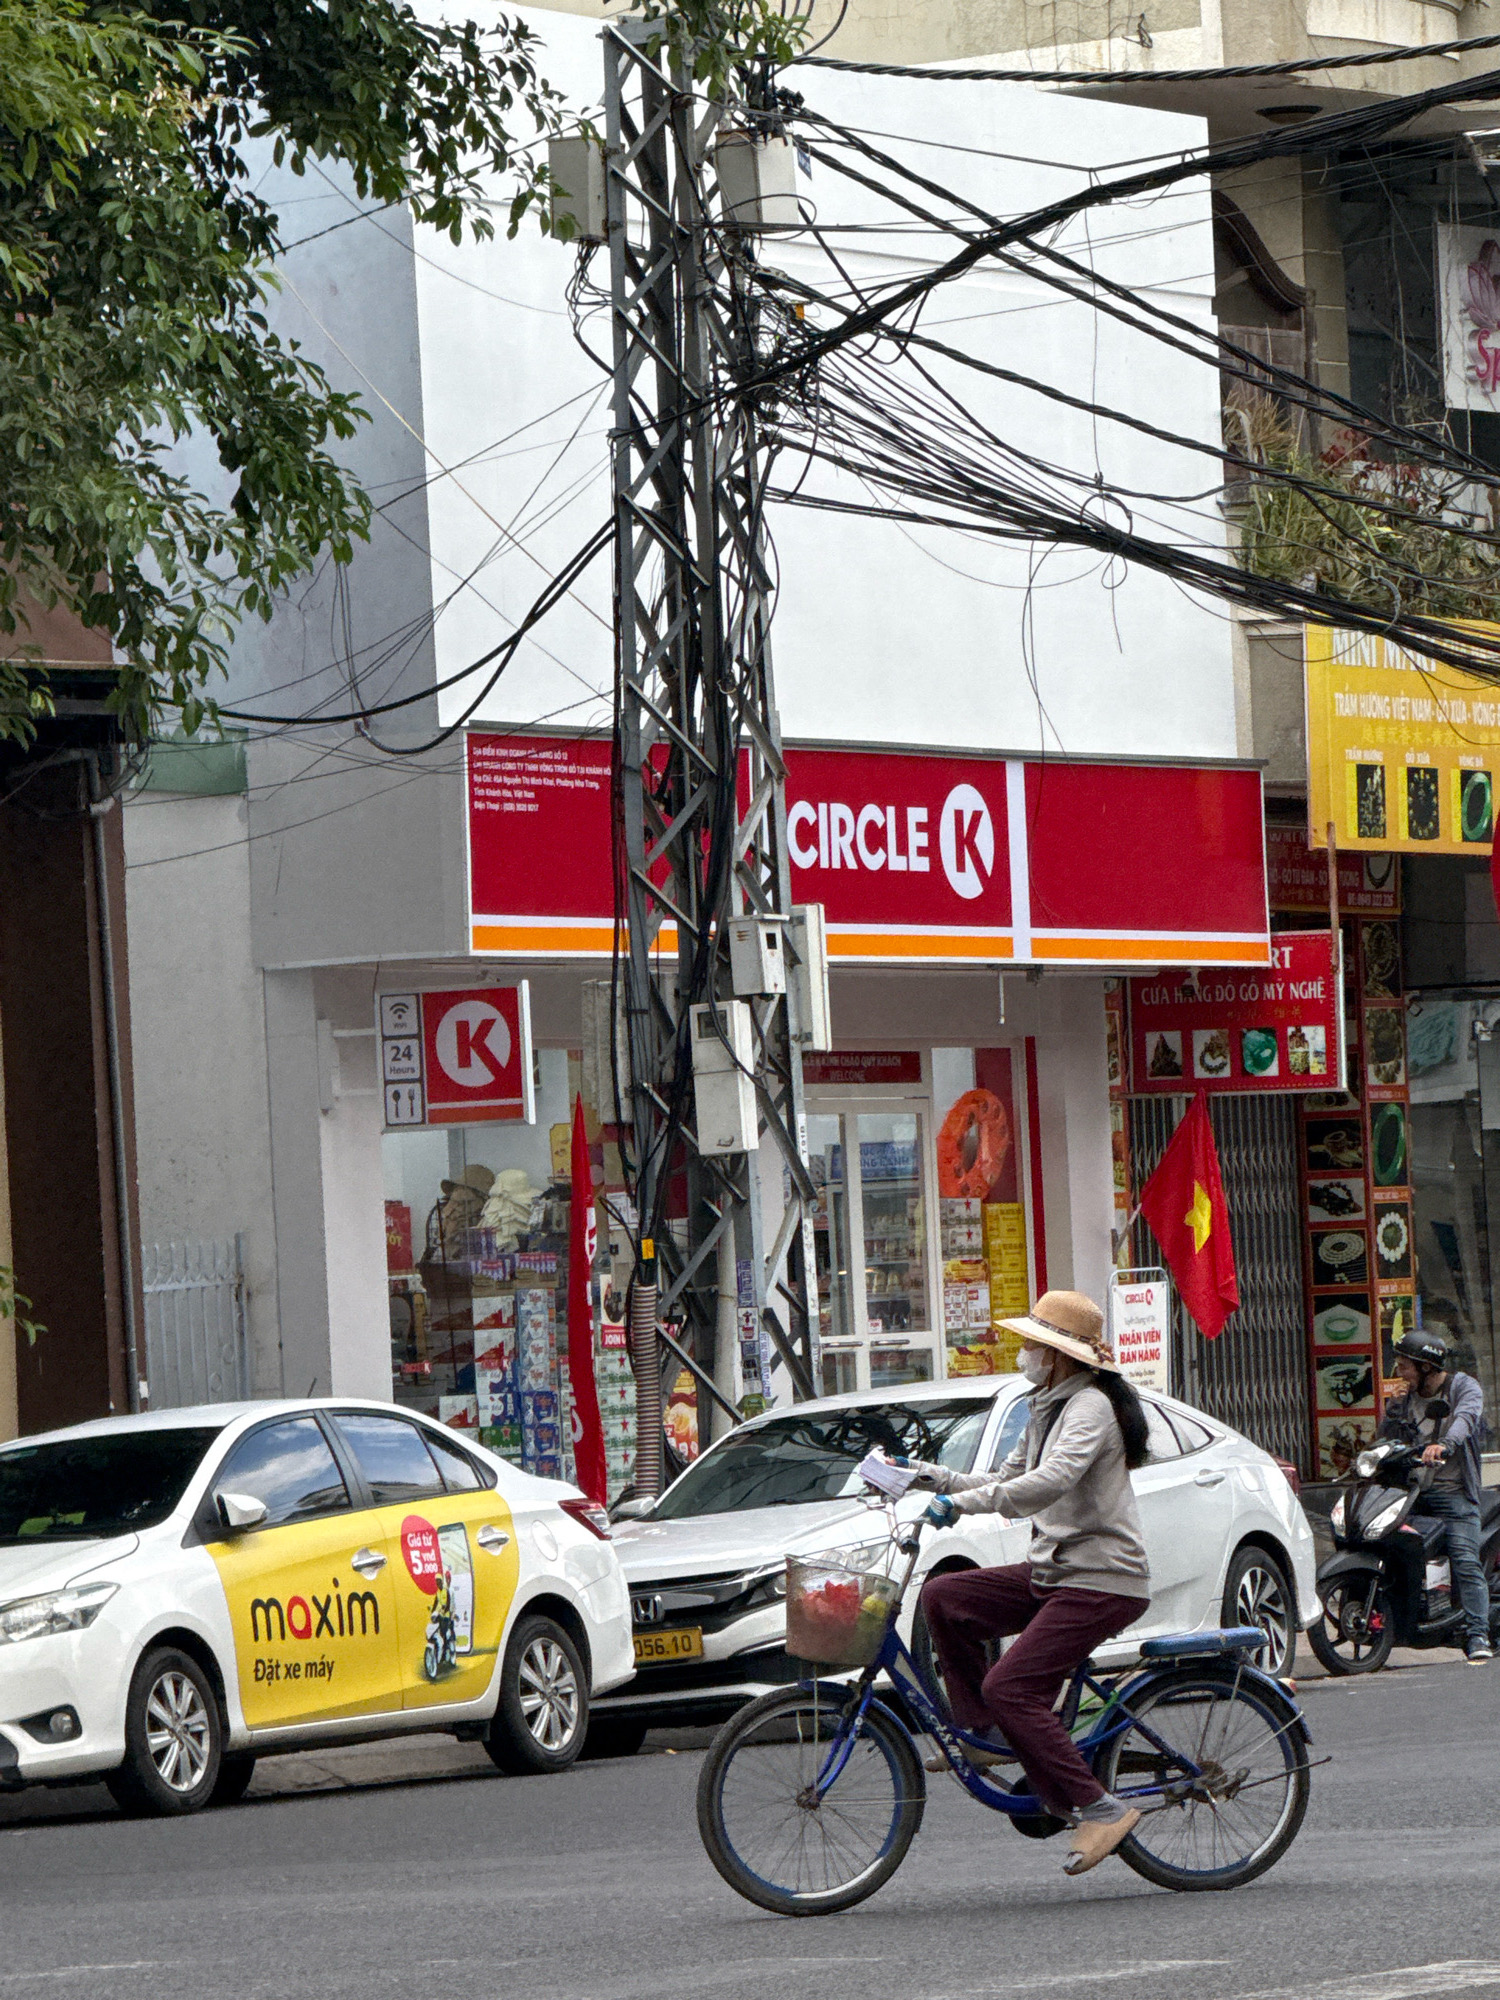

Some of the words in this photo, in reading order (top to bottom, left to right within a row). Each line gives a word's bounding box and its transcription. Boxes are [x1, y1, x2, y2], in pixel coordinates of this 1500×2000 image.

[1412, 697, 1432, 721] NAM
[787, 800, 930, 872] CIRCLE
[947, 796, 994, 897] K
[1271, 946, 1294, 969] RT
[1215, 977, 1235, 1002] ĐỒ
[1239, 975, 1260, 1001] GỖ
[1263, 977, 1284, 1001] MỸ
[1290, 976, 1326, 1004] NGHỆ
[391, 1045, 413, 1061] 24
[445, 1009, 510, 1085] K
[389, 1066, 416, 1075] Hours
[1125, 1293, 1145, 1304] CIRCLE
[604, 1334, 621, 1346] JOIN
[1119, 1329, 1142, 1346] NHÂN
[1143, 1327, 1161, 1344] VIÊN
[1120, 1348, 1137, 1364] BÁN
[1138, 1346, 1160, 1362] HÀNG
[407, 1532, 422, 1548] Giá
[410, 1550, 423, 1575] 5
[421, 1549, 436, 1562] vnd
[251, 1577, 380, 1642] maxim
[254, 1657, 281, 1687] Đặt
[284, 1662, 301, 1679] xe
[304, 1654, 335, 1682] máy
